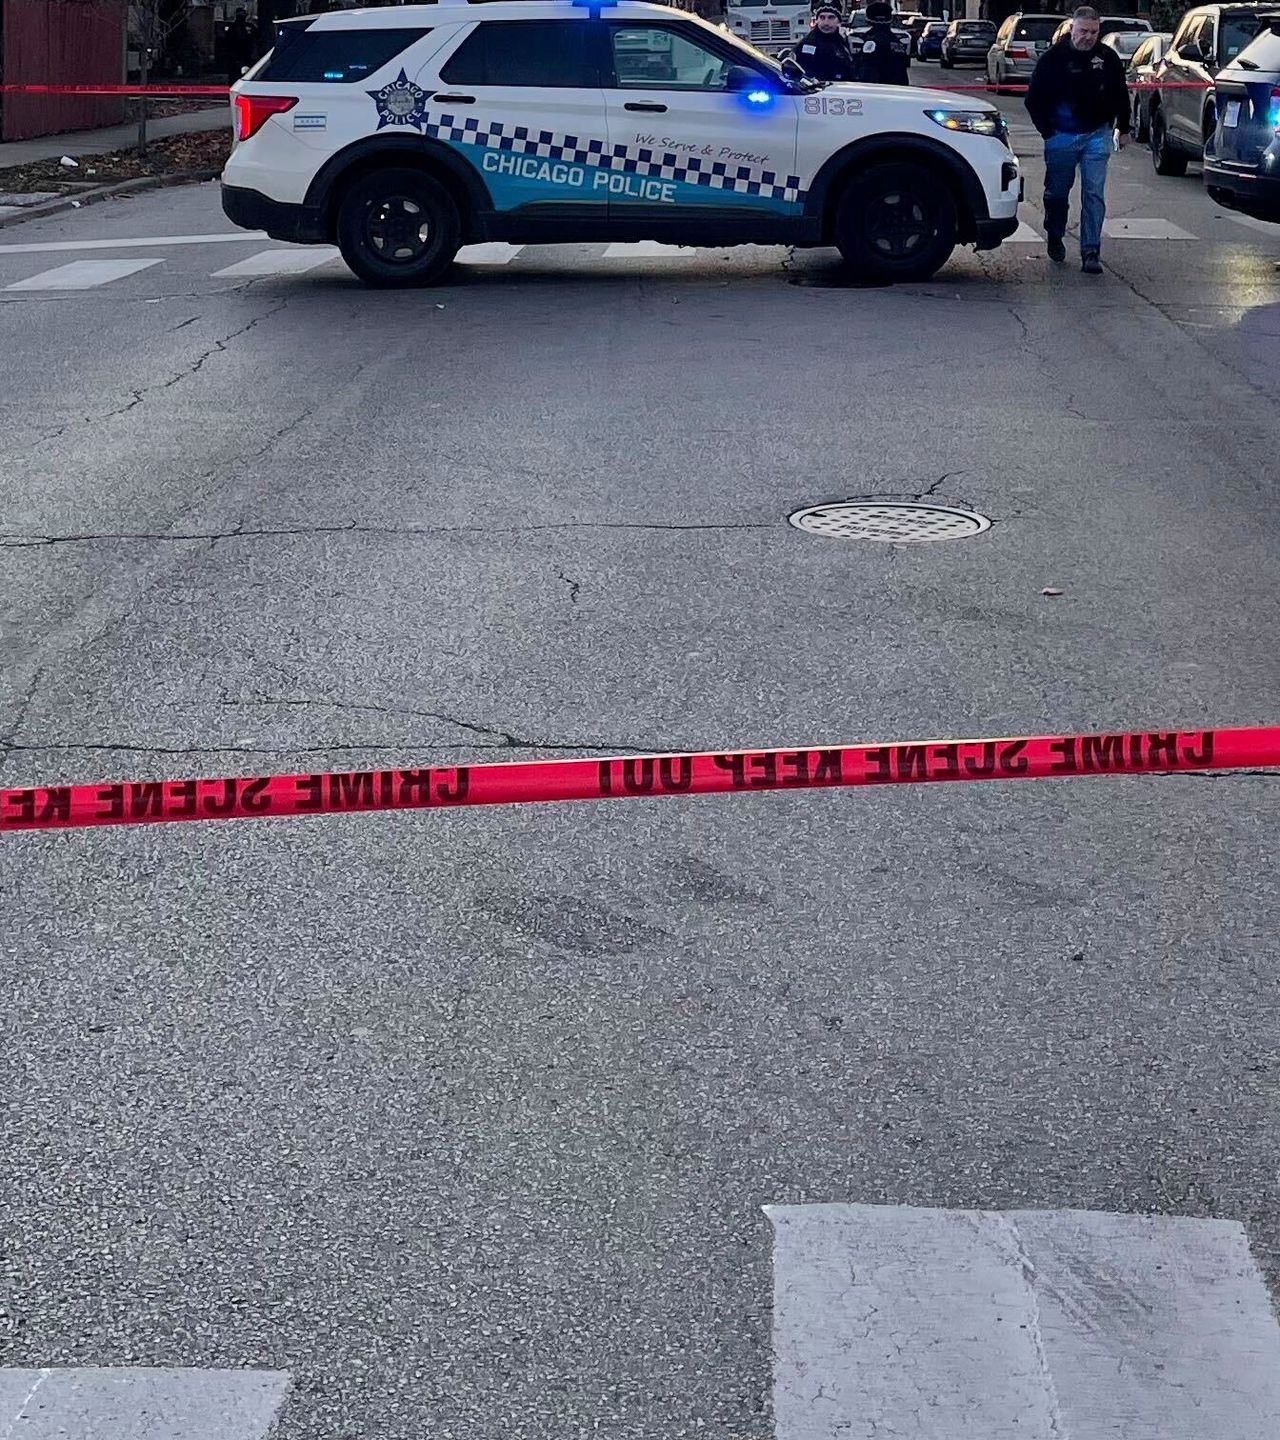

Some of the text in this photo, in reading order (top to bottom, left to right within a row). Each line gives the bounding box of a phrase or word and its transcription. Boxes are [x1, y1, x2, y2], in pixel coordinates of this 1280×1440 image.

[378, 81, 424, 100] CHICAGO
[804, 96, 864, 116] 8132
[379, 109, 422, 125] POLICE
[634, 133, 770, 165] We Serve & Protect
[482, 151, 679, 203] CHICAGO POLICE
